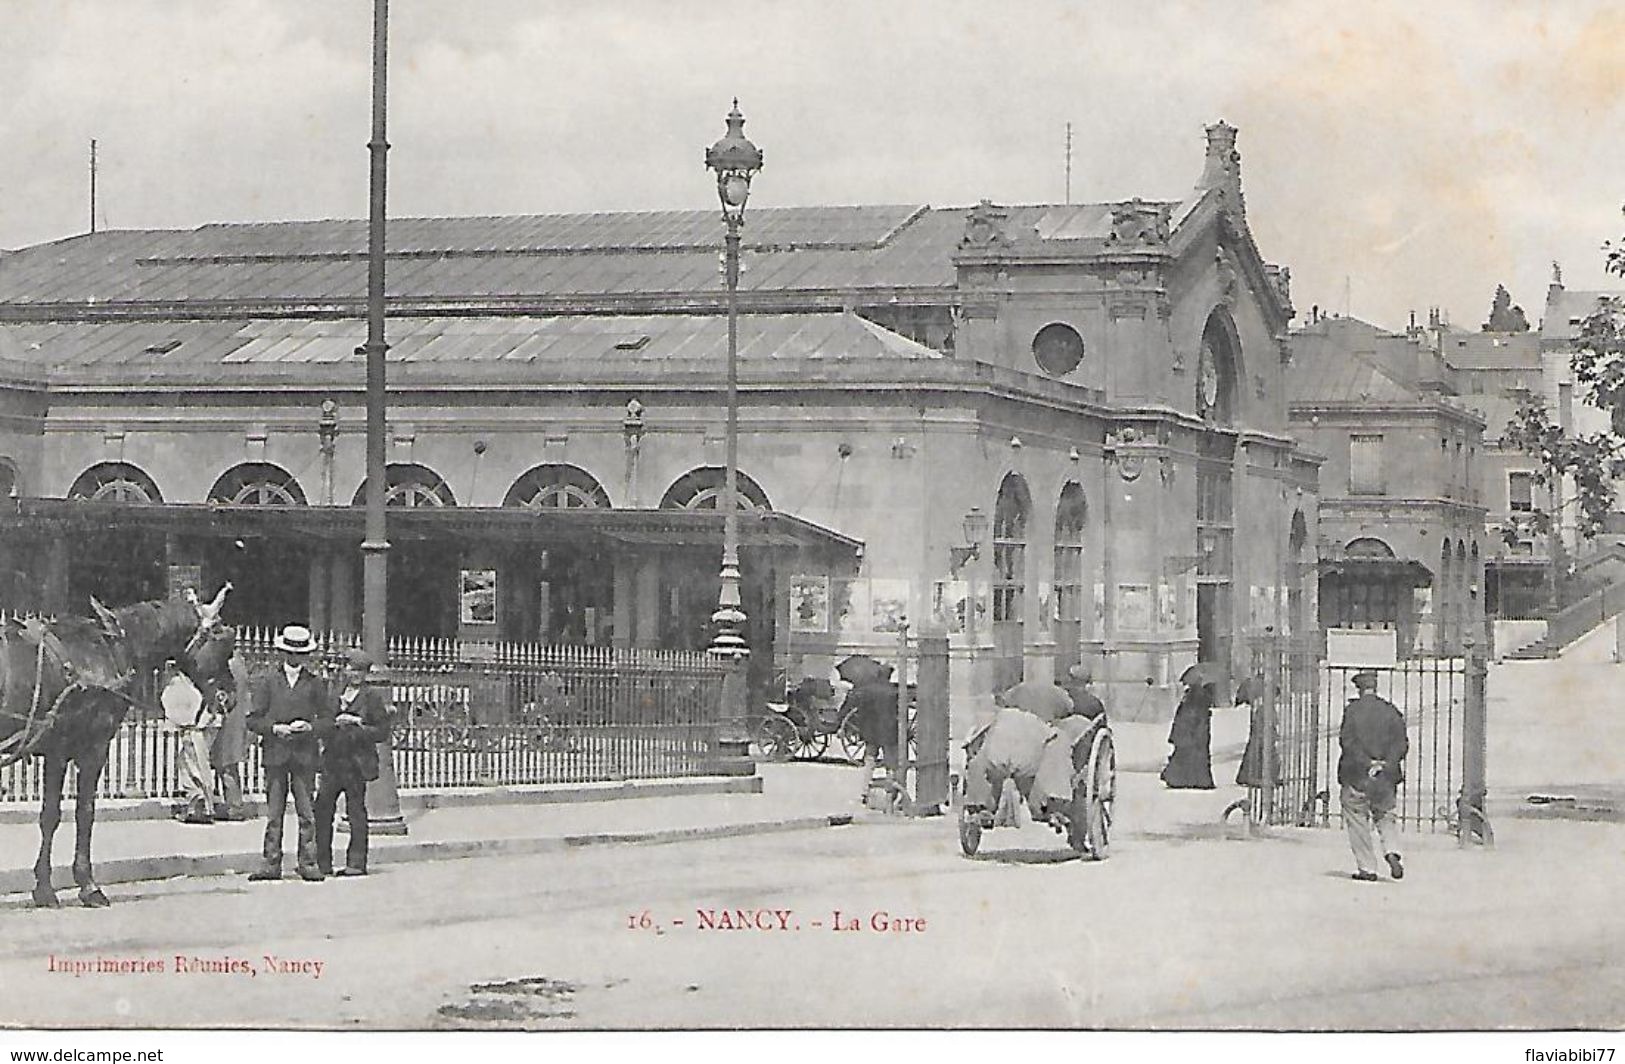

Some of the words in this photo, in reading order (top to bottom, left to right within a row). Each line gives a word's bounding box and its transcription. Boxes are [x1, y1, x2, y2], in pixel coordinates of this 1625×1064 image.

[697, 909, 800, 931] NANCY.
[832, 911, 862, 932] La
[870, 911, 928, 932] Gare
[47, 954, 166, 977] Imprimeries
[264, 954, 324, 979] Nancy
